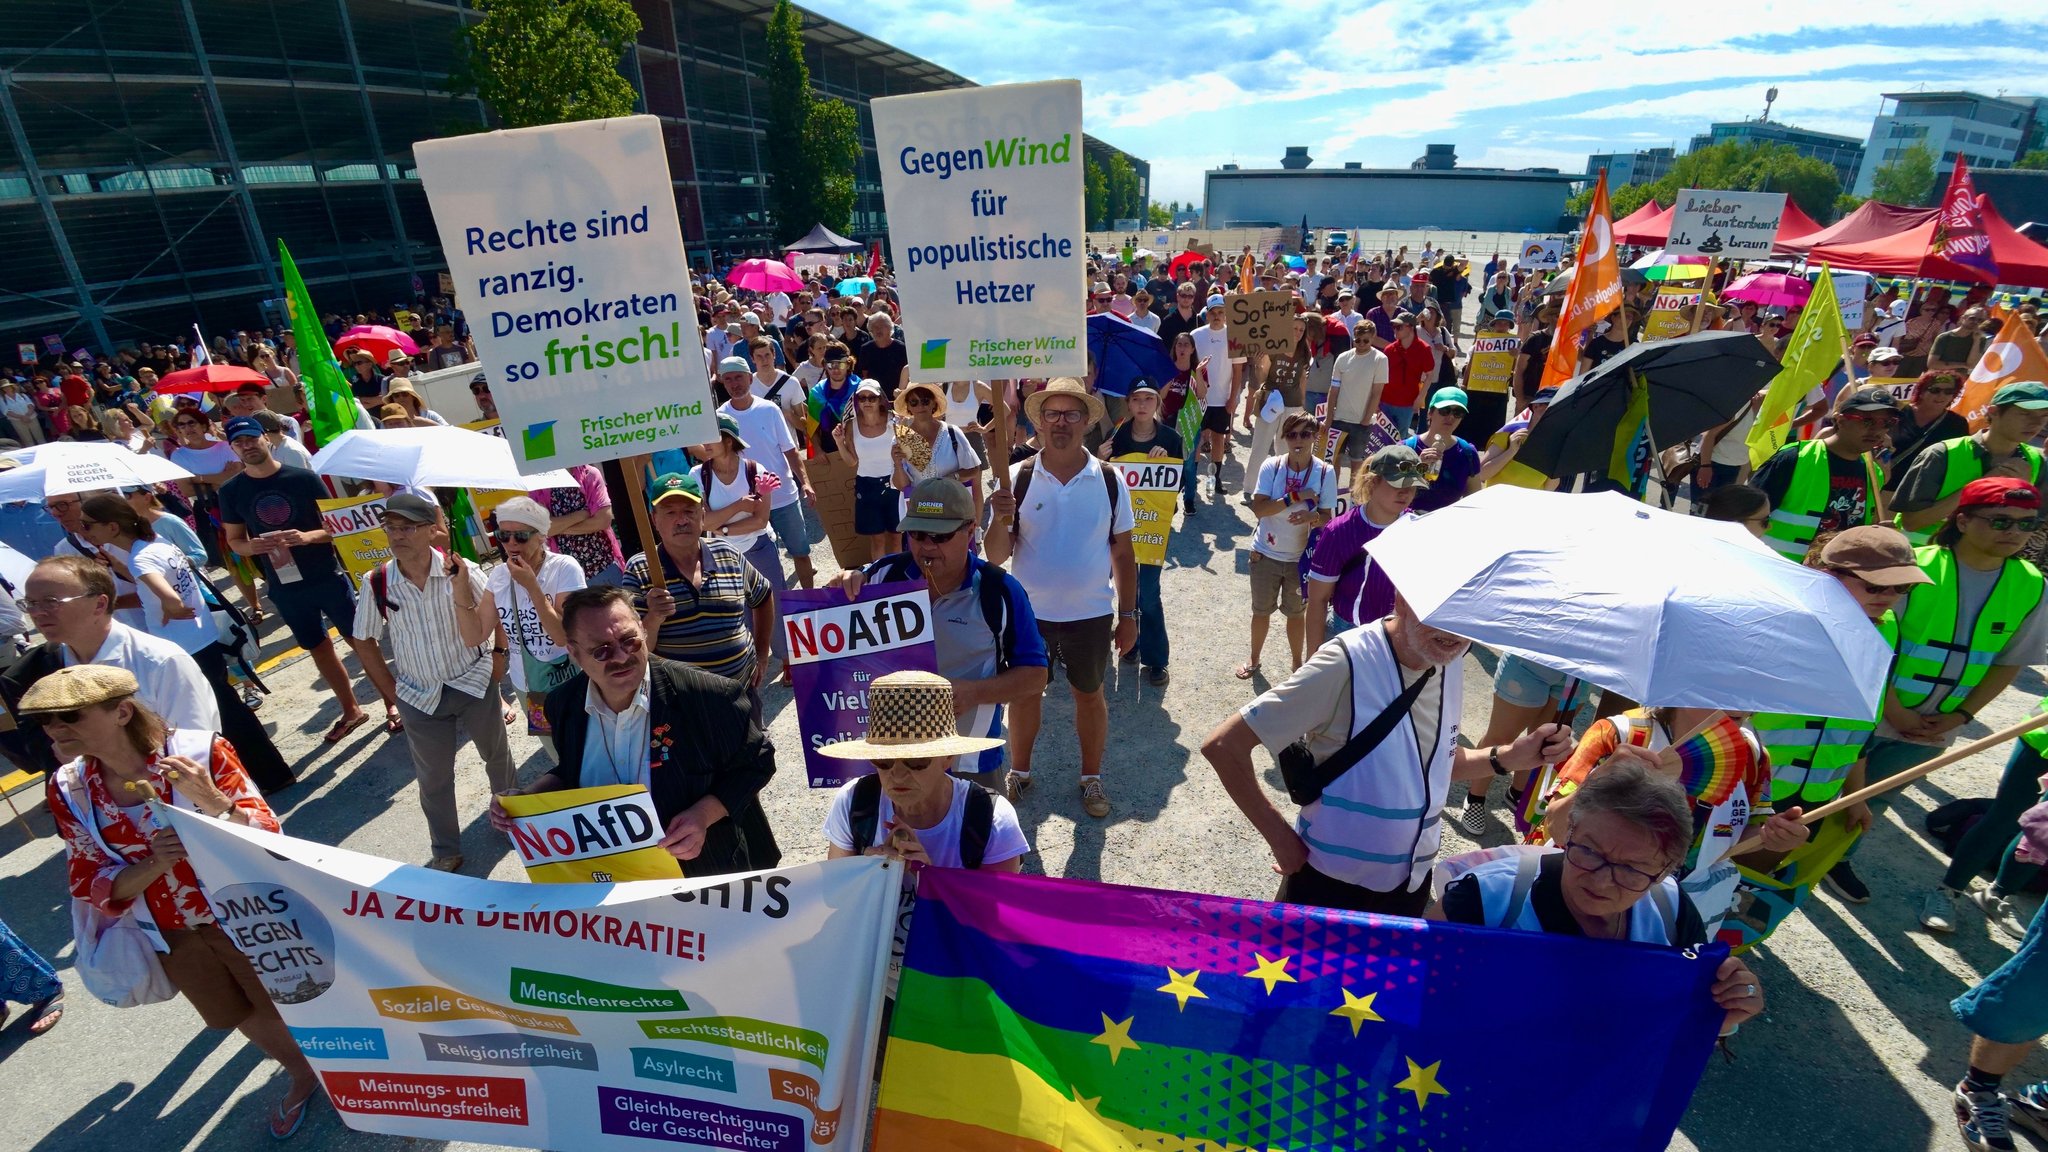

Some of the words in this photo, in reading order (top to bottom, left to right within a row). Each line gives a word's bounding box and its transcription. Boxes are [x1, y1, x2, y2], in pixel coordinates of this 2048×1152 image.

[900, 134, 1071, 180] GegenWind
[971, 189, 1007, 217] für
[465, 219, 577, 256] Rechte
[586, 205, 649, 239] sind
[1671, 232, 1691, 245] als
[907, 233, 1072, 272] populistische
[478, 261, 585, 298] ranzig.
[956, 281, 1035, 305] Hetzer
[492, 292, 678, 338] Demokraten
[1233, 299, 1260, 325] So
[1249, 324, 1270, 338] es
[506, 360, 539, 383] so
[544, 322, 680, 376] frisch!
[1265, 339, 1288, 350] an
[968, 353, 1033, 368] Salzweg
[582, 428, 657, 450] Salzweg
[67, 462, 100, 470] OMAS
[67, 467, 107, 477] GEGEN
[68, 473, 114, 484] RECHTS
[787, 600, 925, 658] NoAfD
[853, 671, 871, 682] für
[822, 690, 869, 711] Viel
[511, 803, 655, 861] NoAfD
[592, 871, 612, 884] für
[342, 890, 384, 919] JA
[395, 895, 464, 925] ZUR
[520, 982, 674, 1008] Menschenrechte
[382, 996, 450, 1015] Soziale
[456, 997, 568, 1032] Gerechtigkeit
[438, 1043, 583, 1061] Religionsfreiheit
[655, 1022, 827, 1063] Rechtsstaatlichkeit
[643, 1056, 724, 1082] Asylrecht
[358, 1079, 452, 1098] Meinungs-
[457, 1083, 489, 1097] und
[334, 1094, 522, 1119] Versammlungsfreiheit
[615, 1096, 790, 1137] Gleichberechtigung
[629, 1117, 658, 1132] der
[662, 1121, 779, 1150] Geschlechter
